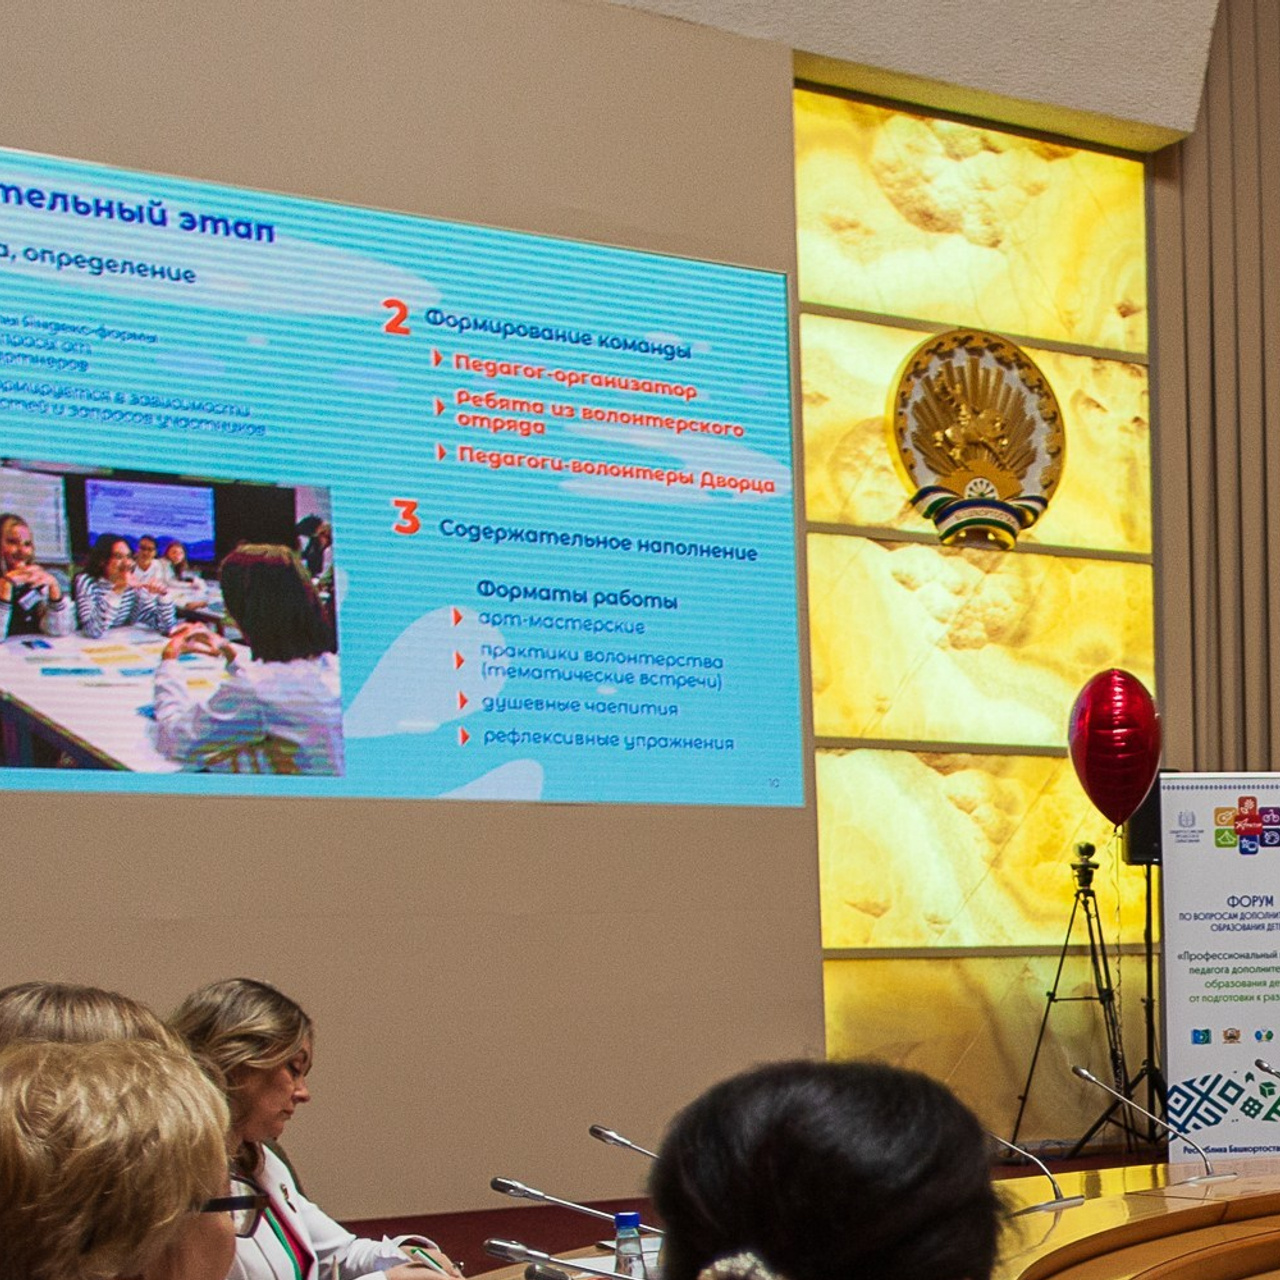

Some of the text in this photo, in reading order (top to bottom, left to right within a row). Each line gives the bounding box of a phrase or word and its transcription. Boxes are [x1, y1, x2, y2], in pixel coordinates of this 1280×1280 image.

[179, 211, 276, 242] этап
[23, 247, 197, 284] определение
[382, 298, 411, 336] 2
[425, 307, 692, 360] Формирование команды
[454, 353, 698, 402] Педагог-организатор
[457, 389, 745, 438] Ребята из волонтерского
[457, 412, 546, 437] отряда
[457, 445, 776, 495] Педагоги-волонтеры Дворца
[393, 499, 421, 535] 3
[439, 519, 758, 562] Содержательное наполнение
[477, 579, 679, 611] Форматы работы
[478, 611, 646, 636] арт-мастерские
[481, 644, 724, 671] практики волонтерства
[481, 664, 723, 692] (тематические встречи)
[482, 695, 679, 717] душевные чаепития
[483, 728, 735, 750] рефлексивные упражнения
[1226, 895, 1274, 908] ФОРУМ
[1179, 912, 1192, 921] ПО
[1194, 911, 1238, 921] ВОПРОСАМ
[1211, 922, 1265, 932] ОБРАЗОВАНИЯ
[1177, 950, 1278, 962] «Профессиональный
[1189, 966, 1229, 975] педагога
[1205, 979, 1267, 989] образования
[1189, 995, 1199, 1003] от
[1202, 994, 1254, 1004] подготовки
